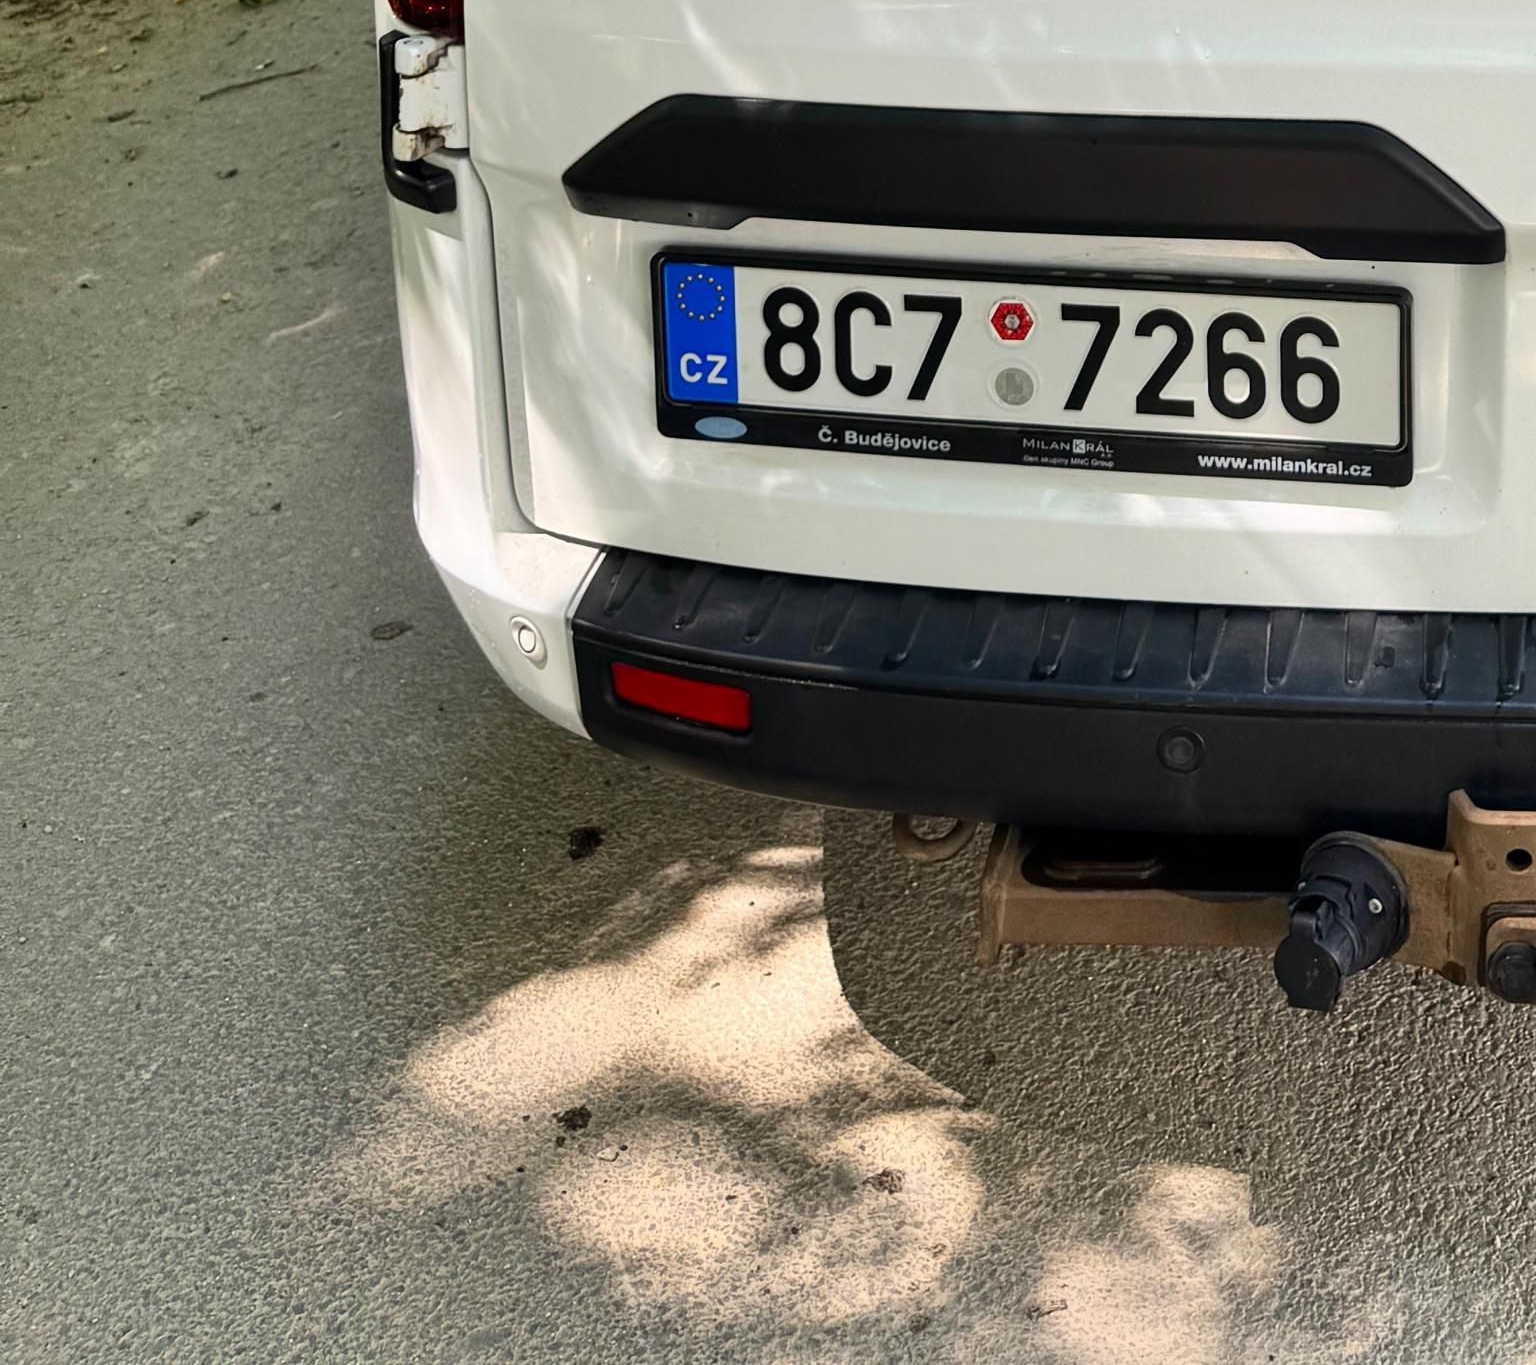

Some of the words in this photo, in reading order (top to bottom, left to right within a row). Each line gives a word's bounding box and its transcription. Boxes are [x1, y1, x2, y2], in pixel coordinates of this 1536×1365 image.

[679, 352, 729, 385] CZ
[761, 285, 963, 402] 8C7
[1060, 302, 1341, 424] 7266
[817, 425, 838, 443] Č.
[845, 430, 951, 451] Budějovice
[1198, 455, 1372, 477] www.milankral.cz
